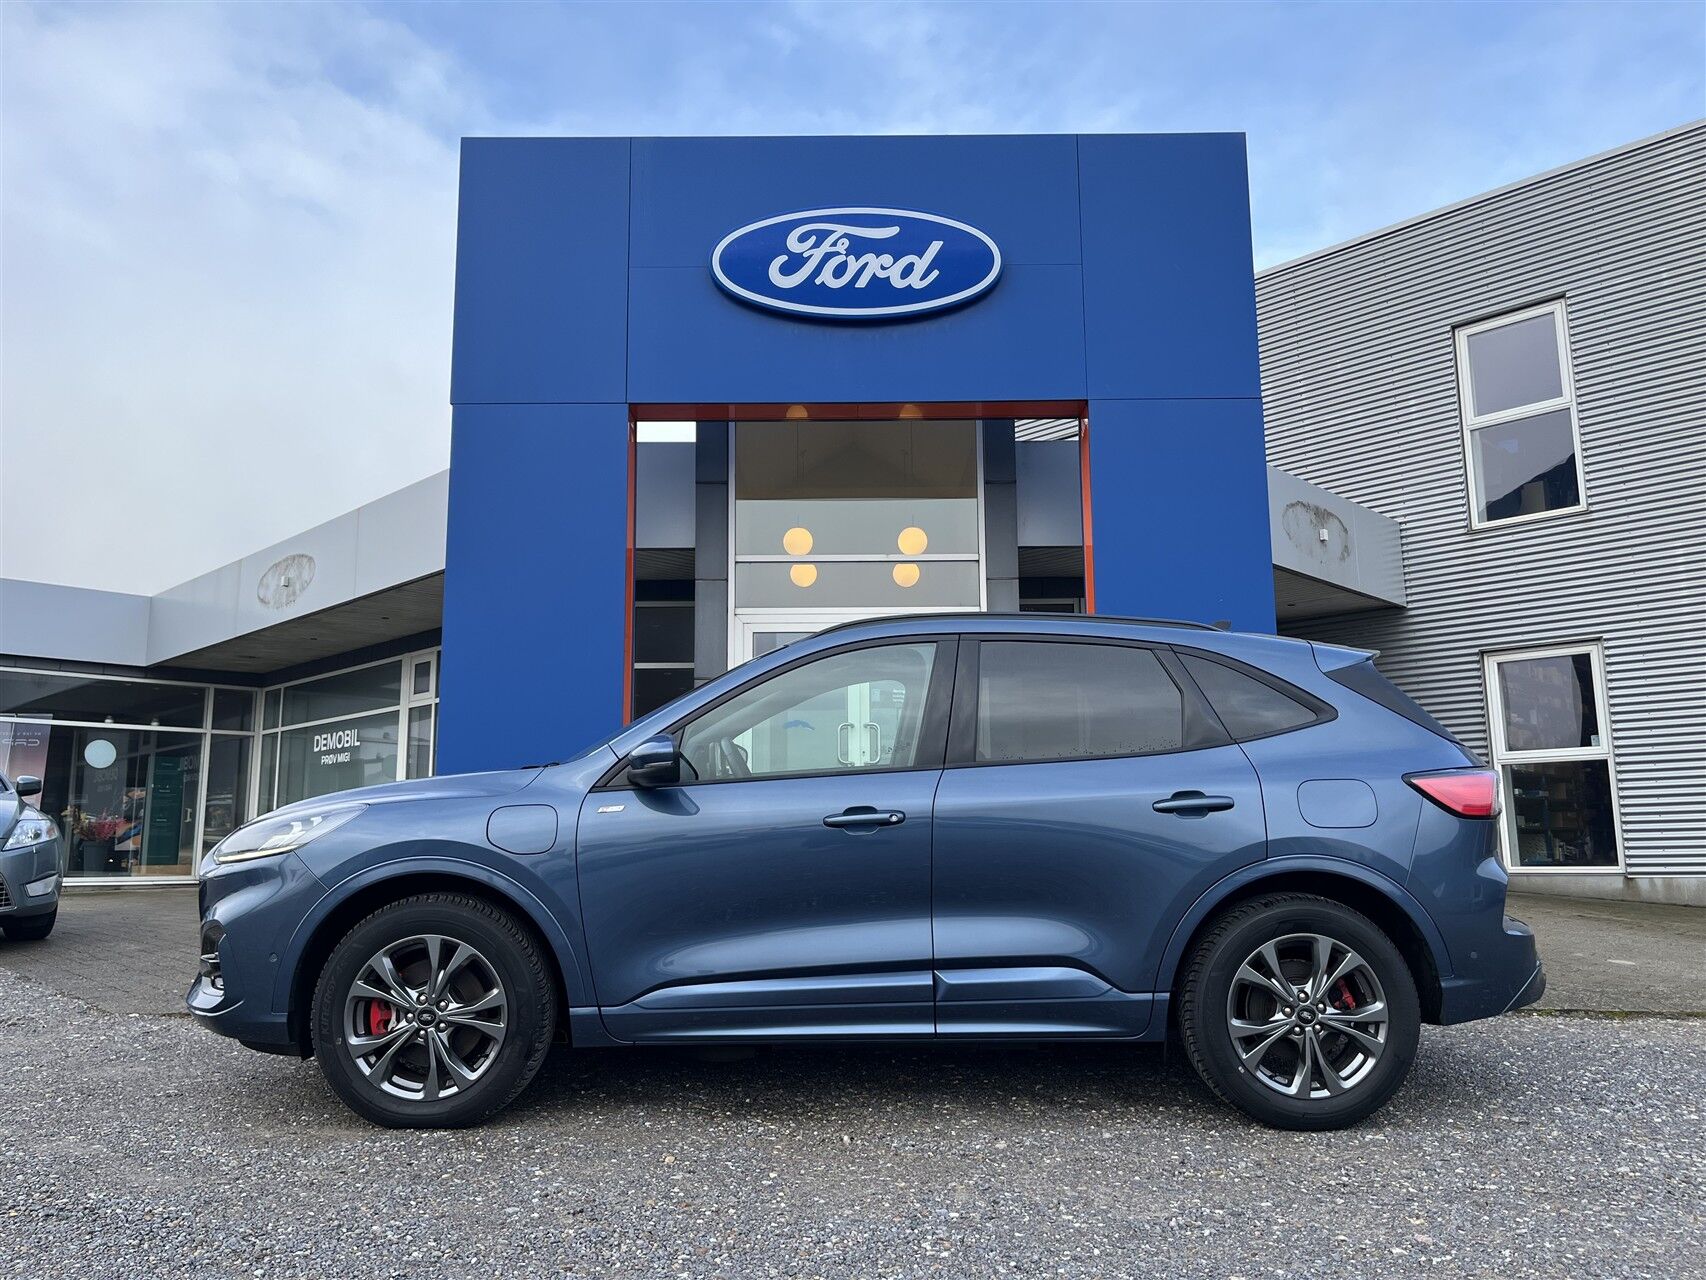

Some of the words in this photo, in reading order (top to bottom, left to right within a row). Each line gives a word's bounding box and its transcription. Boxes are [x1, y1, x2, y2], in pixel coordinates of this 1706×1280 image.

[768, 223, 943, 289] Ford
[314, 729, 360, 752] DEMOBIL
[321, 754, 337, 765] PRØV
